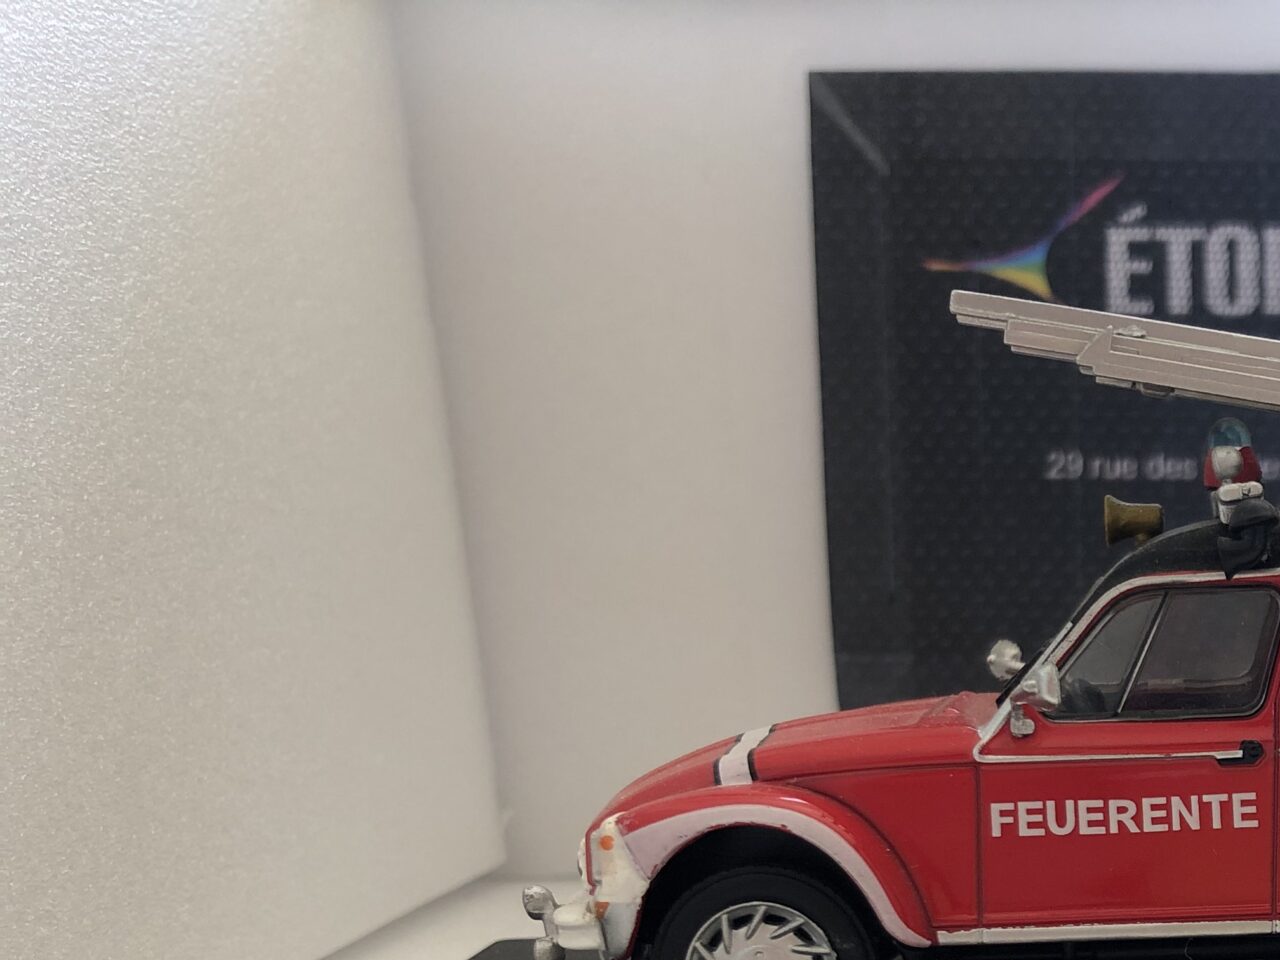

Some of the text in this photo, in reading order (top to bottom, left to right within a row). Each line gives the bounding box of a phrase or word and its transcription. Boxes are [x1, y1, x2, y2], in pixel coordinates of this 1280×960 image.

[1046, 447, 1199, 481] 29 rue des
[990, 791, 1260, 838] FEUERENTE
